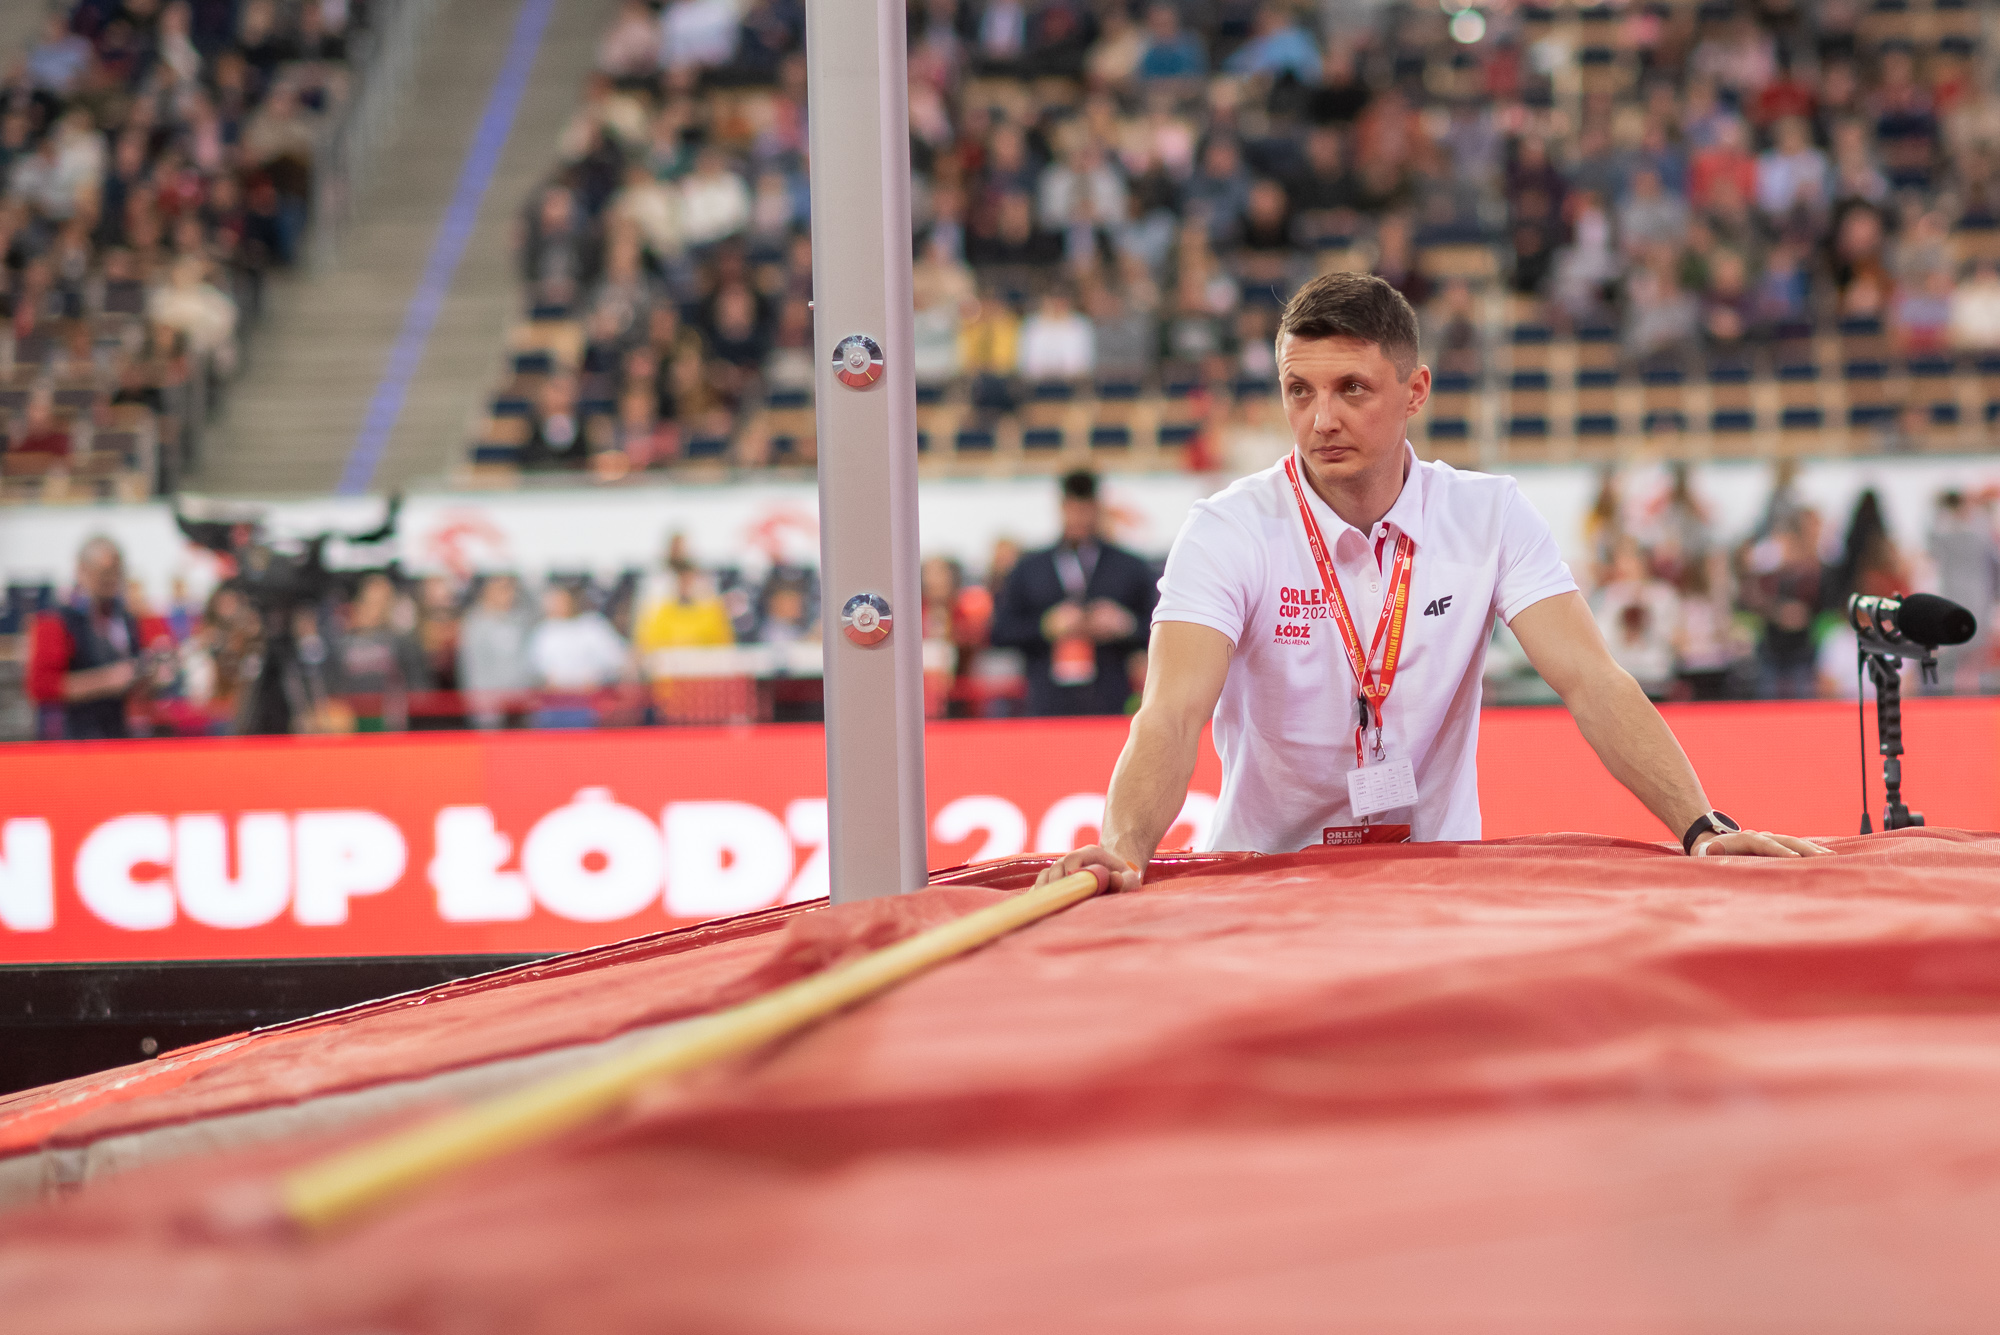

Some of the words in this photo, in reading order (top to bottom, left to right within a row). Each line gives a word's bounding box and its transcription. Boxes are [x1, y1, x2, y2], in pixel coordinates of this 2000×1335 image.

[1279, 605, 1300, 618] CUP
[1423, 594, 1453, 617] 4F
[1275, 622, 1311, 639] ŁÓDŹ
[1391, 608, 1403, 638] KOLEGIUM
[1385, 638, 1399, 671] CENTRALNE
[1326, 831, 1362, 839] ORLEN
[75, 806, 408, 932] CUP
